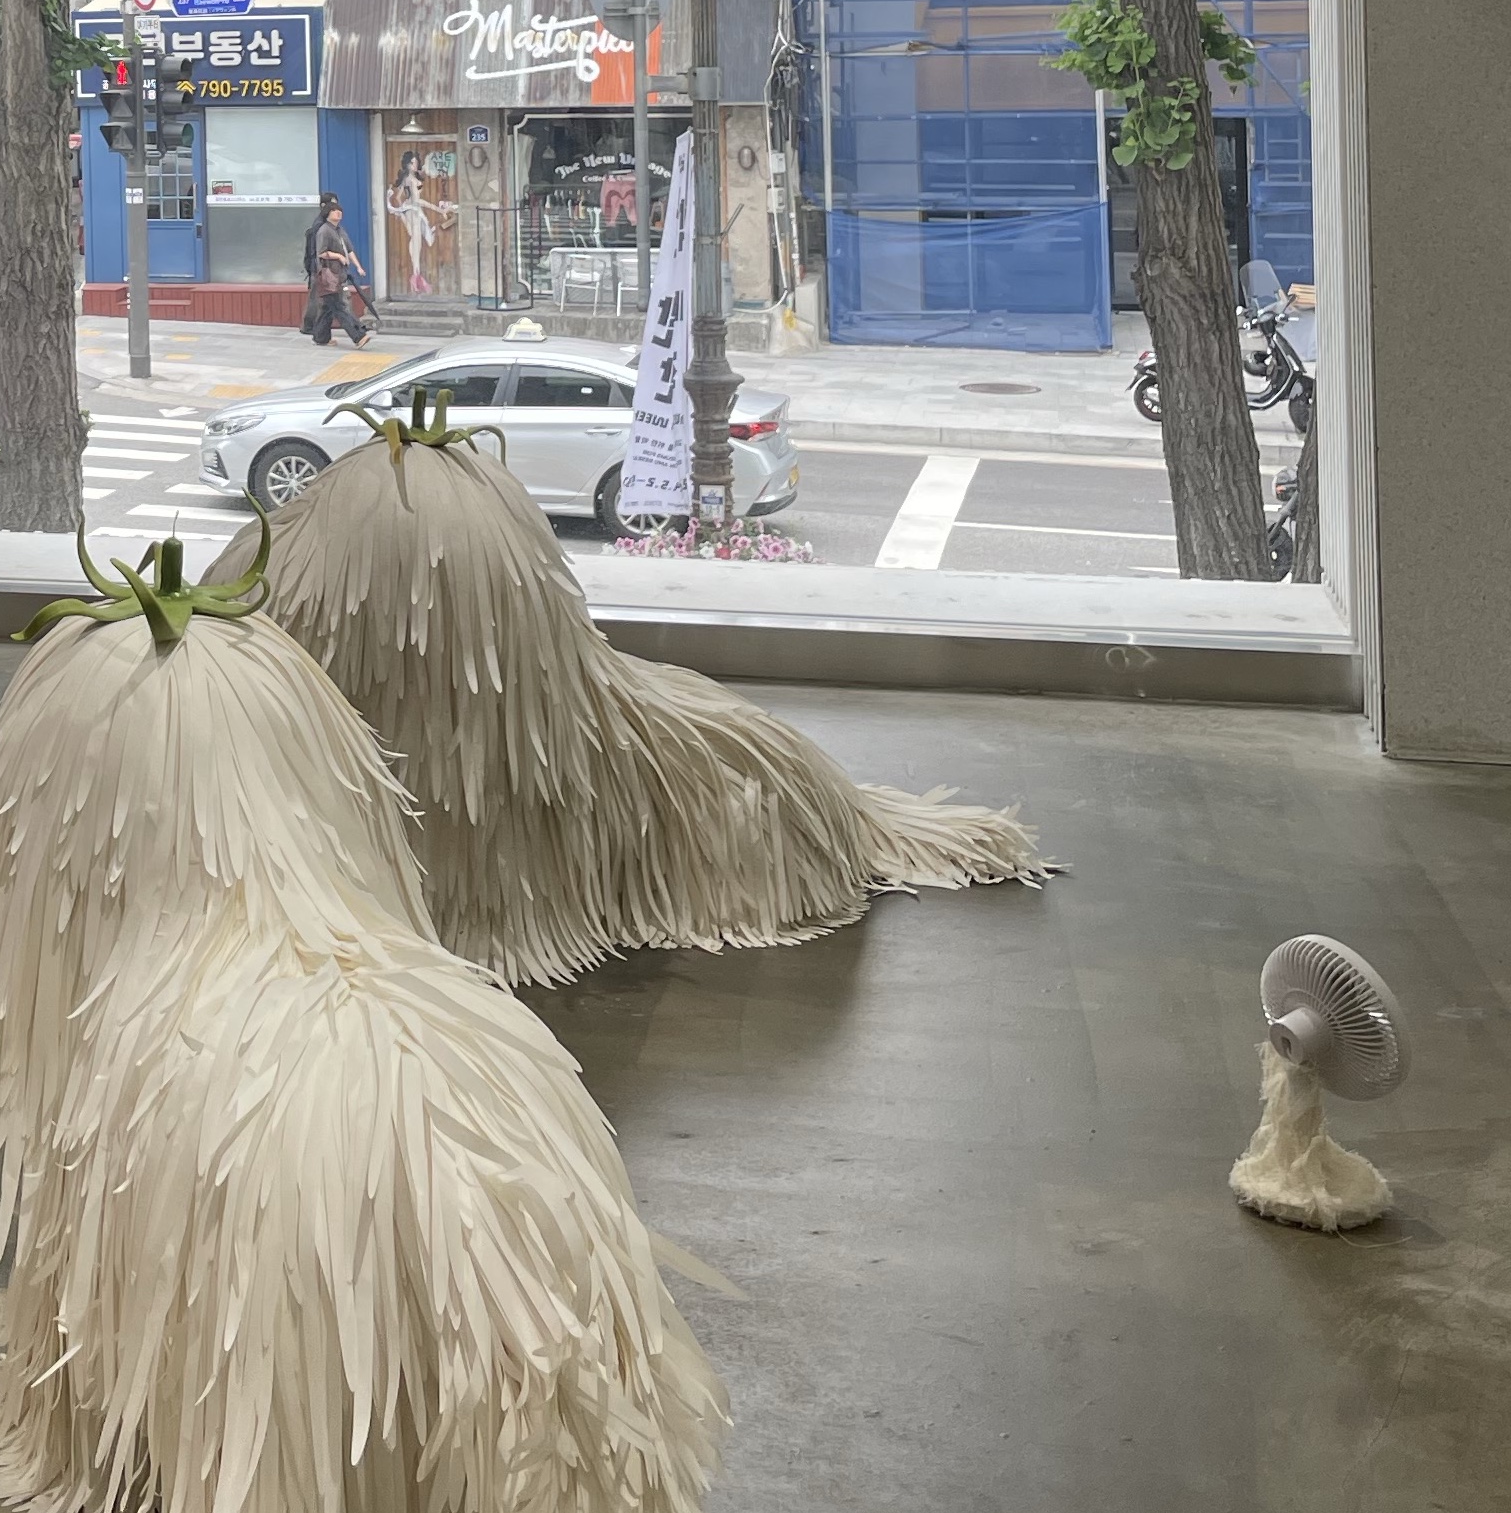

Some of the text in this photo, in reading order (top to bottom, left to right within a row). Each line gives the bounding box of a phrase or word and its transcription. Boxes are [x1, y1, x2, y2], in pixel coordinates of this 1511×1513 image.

[198, 79, 284, 98] 790-7795
[471, 133, 486, 141] 235
[431, 151, 451, 161] ARE
[554, 162, 580, 179] The
[583, 153, 615, 167] New
